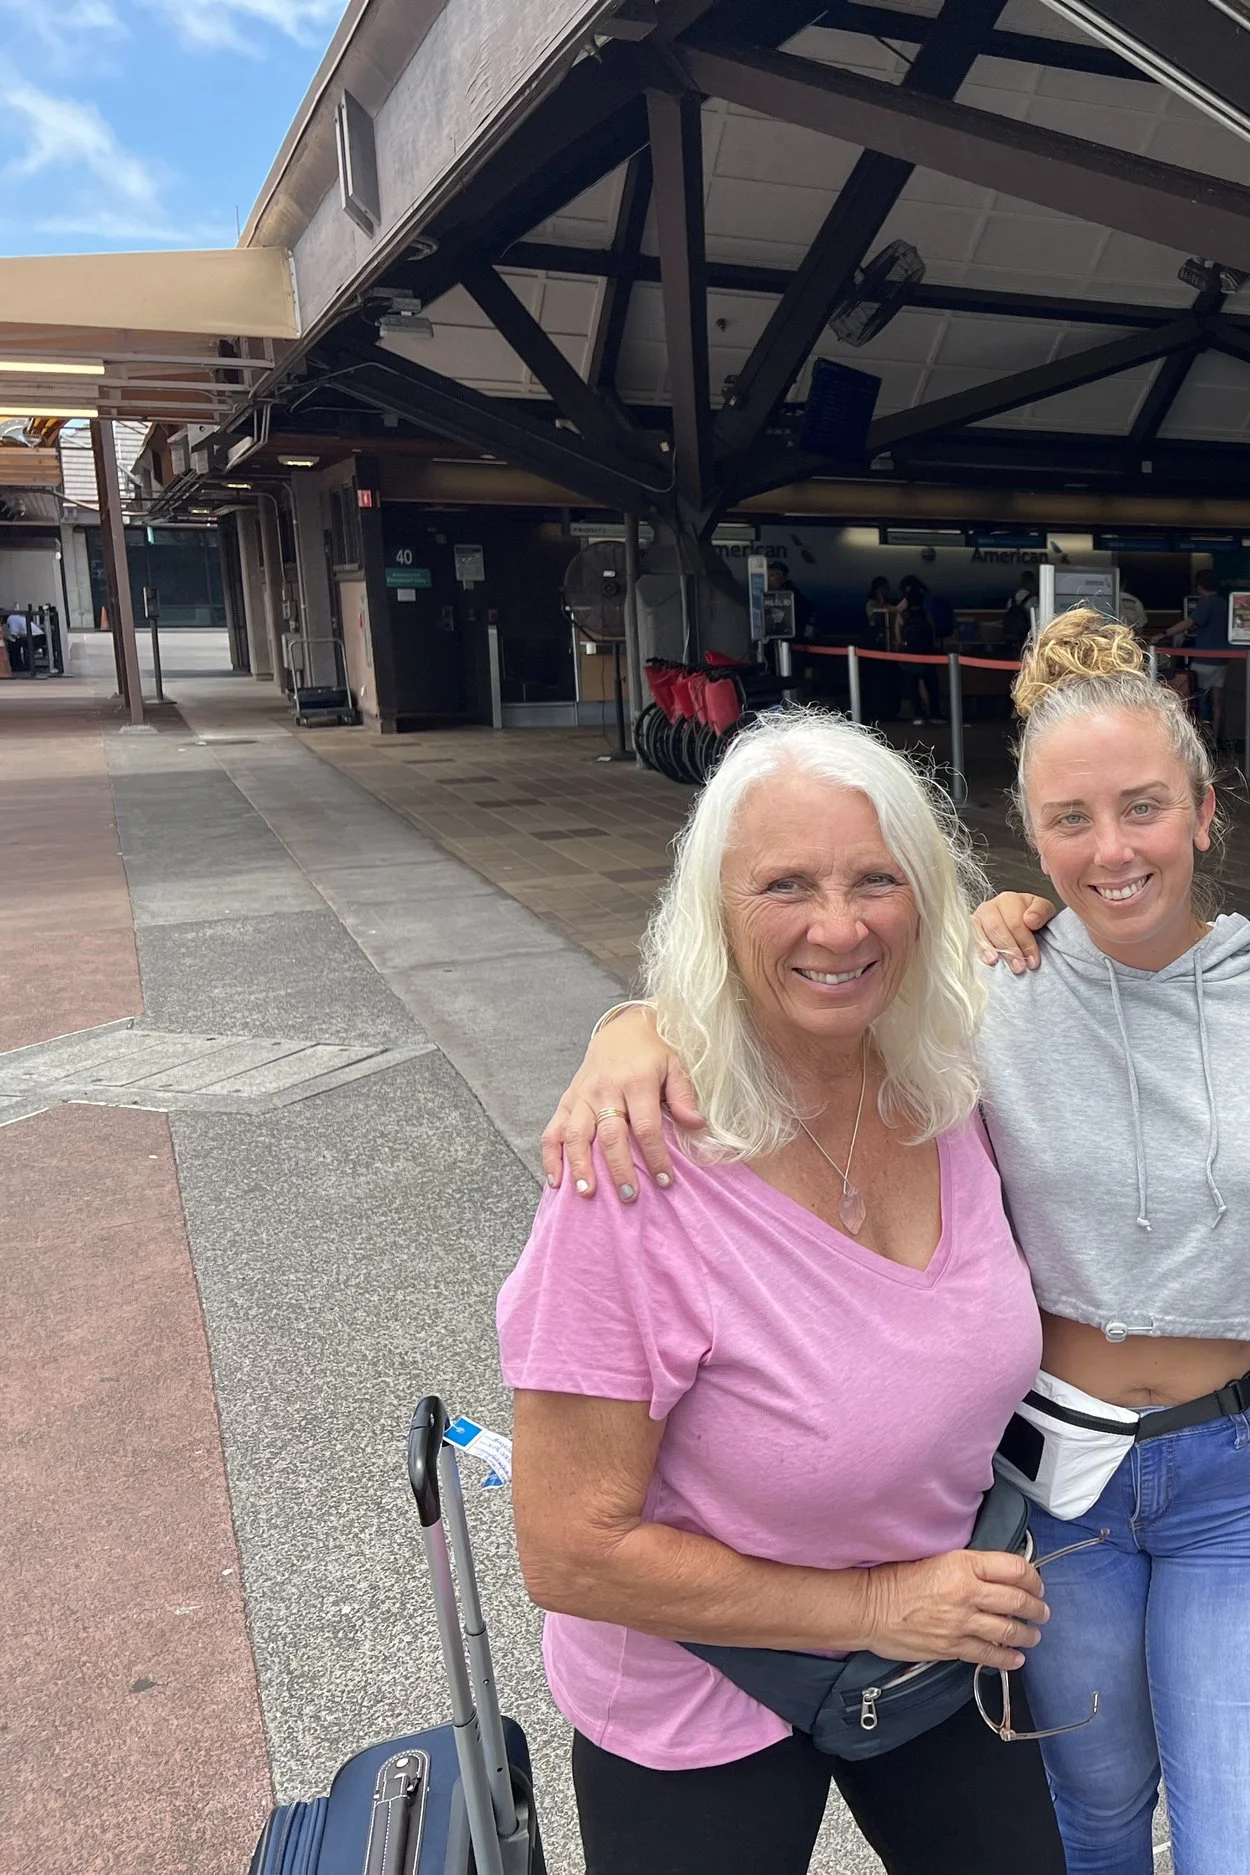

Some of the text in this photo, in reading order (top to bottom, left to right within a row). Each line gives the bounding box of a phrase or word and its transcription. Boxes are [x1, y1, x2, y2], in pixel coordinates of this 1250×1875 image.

[396, 549, 412, 565] 40
[712, 544, 788, 558] merican
[972, 547, 1048, 563] American
